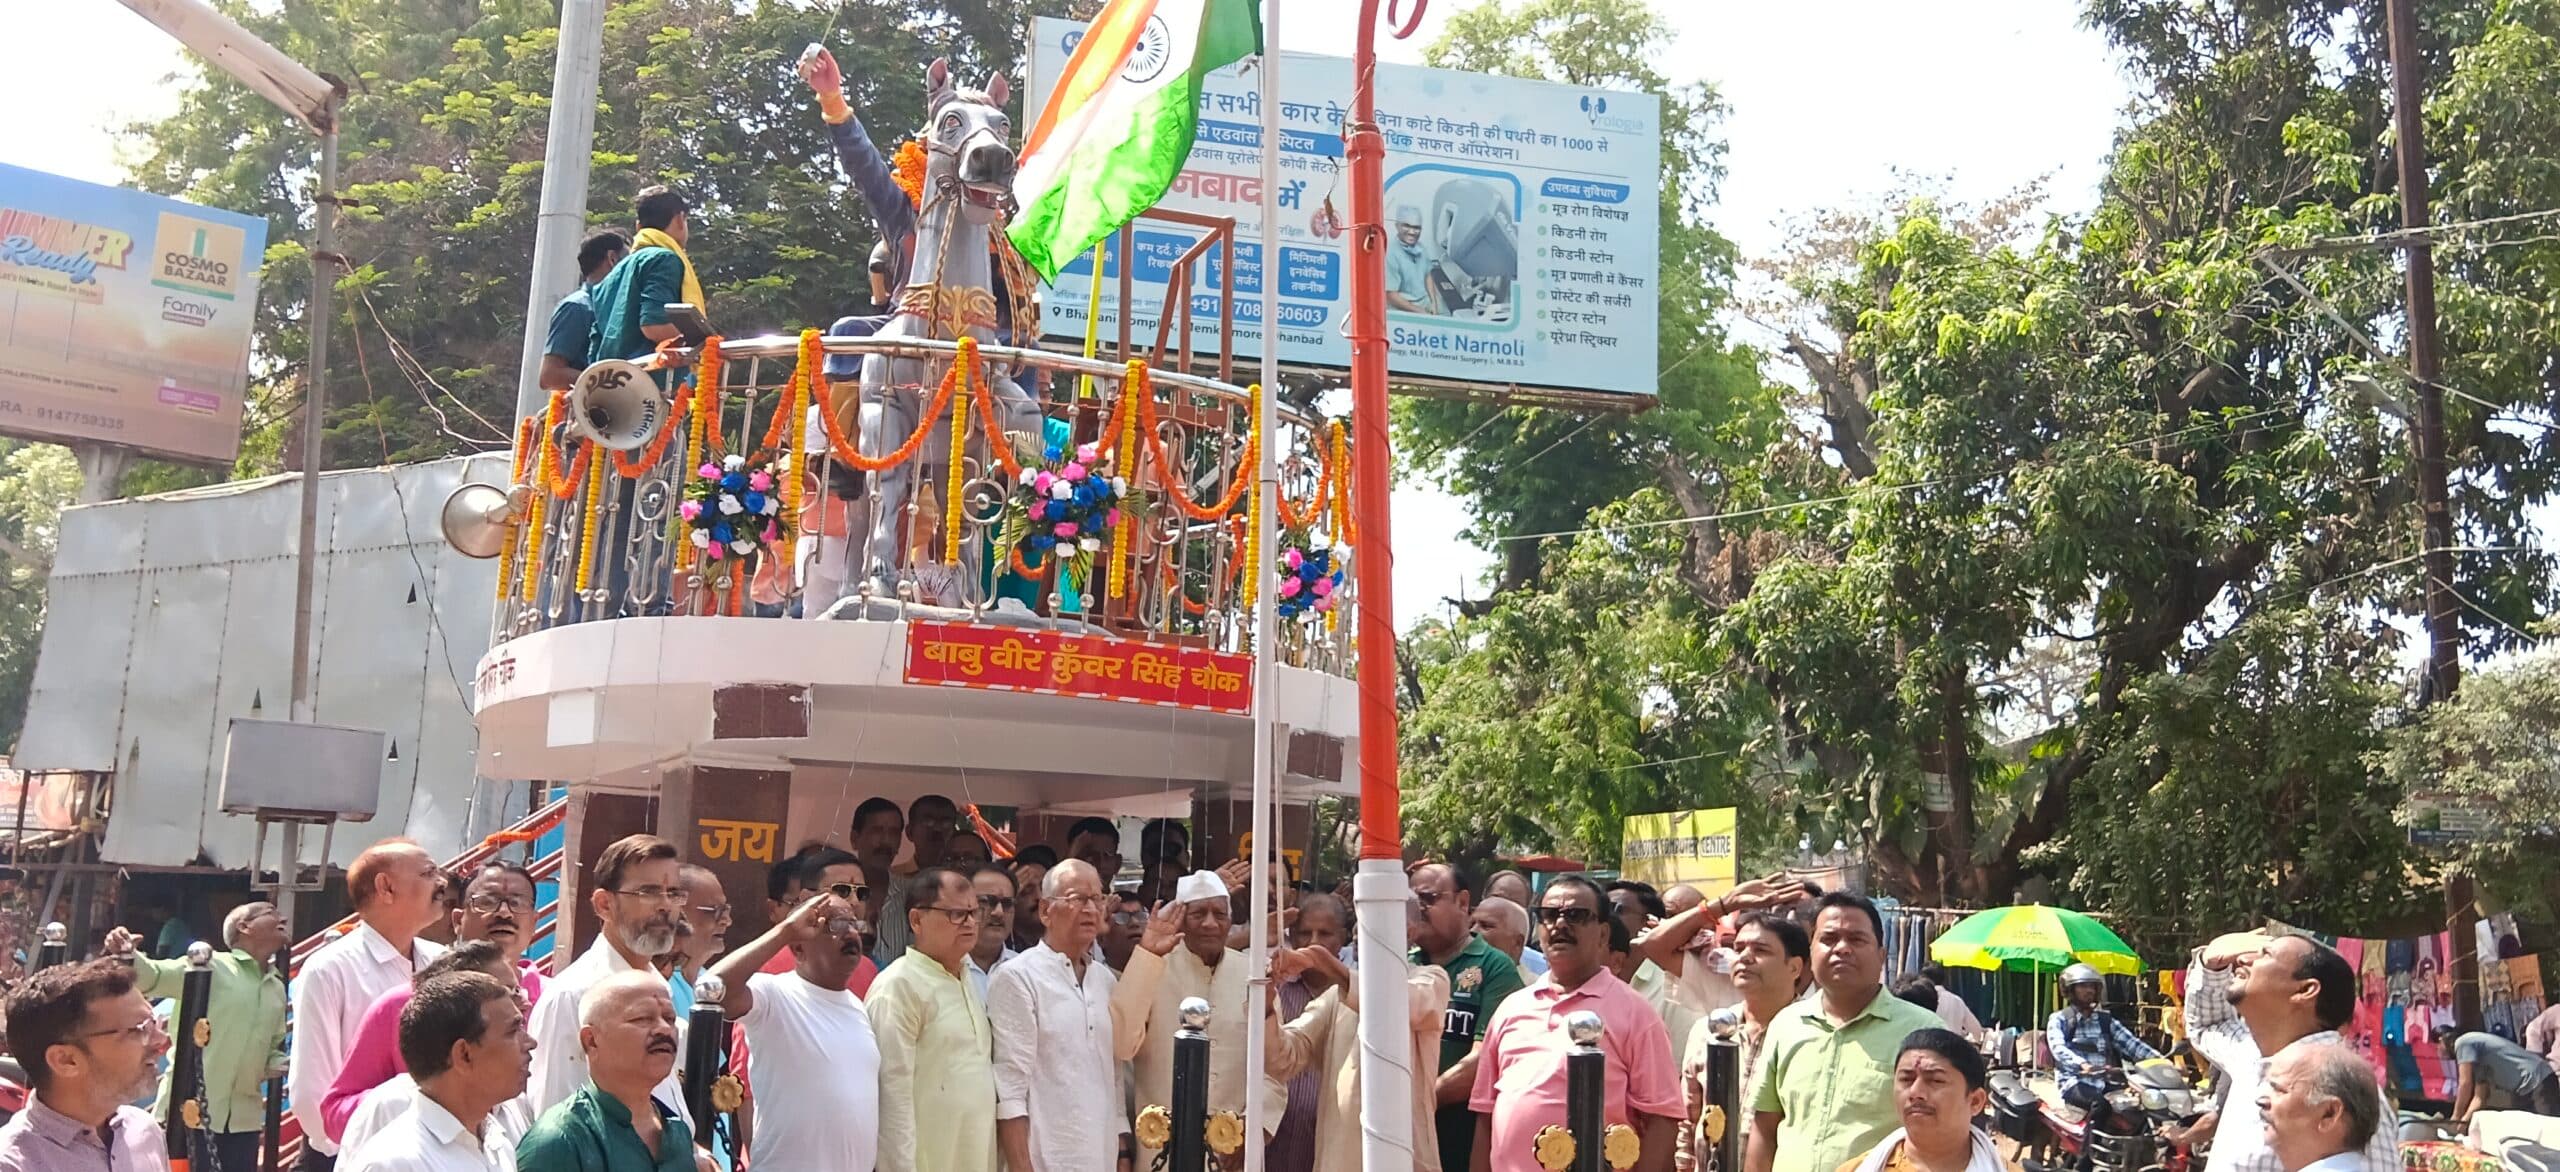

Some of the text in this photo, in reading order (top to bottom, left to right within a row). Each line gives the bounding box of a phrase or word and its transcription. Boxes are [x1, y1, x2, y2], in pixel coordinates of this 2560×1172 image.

[1279, 101, 1322, 124] कार
[1211, 127, 1257, 144] एडवांस
[1374, 109, 1609, 153] बिना काटे किडनी की पथरी का 1000 से
[1383, 129, 1413, 147] धिक
[1417, 136, 1454, 153] सफल
[1171, 169, 1265, 206] नबाद
[1571, 203, 1589, 217] रोग
[1551, 224, 1608, 242] किडनी रोग
[165, 252, 228, 275] COSMO
[1551, 245, 1614, 265] किडनी स्टोन
[164, 264, 227, 287] BAZAAR
[162, 296, 217, 321] Family
[1585, 291, 1600, 305] की
[1065, 308, 1116, 324] Bhaani
[1278, 333, 1323, 346] hanbad
[1581, 310, 1606, 326] स्टोन
[1393, 327, 1525, 357] Saket Narnoli
[990, 637, 1046, 672] वीर
[1131, 652, 1184, 689] सिंह
[1191, 660, 1244, 693] चौक
[698, 819, 779, 863] जय
[1700, 834, 1731, 858] CENTRE
